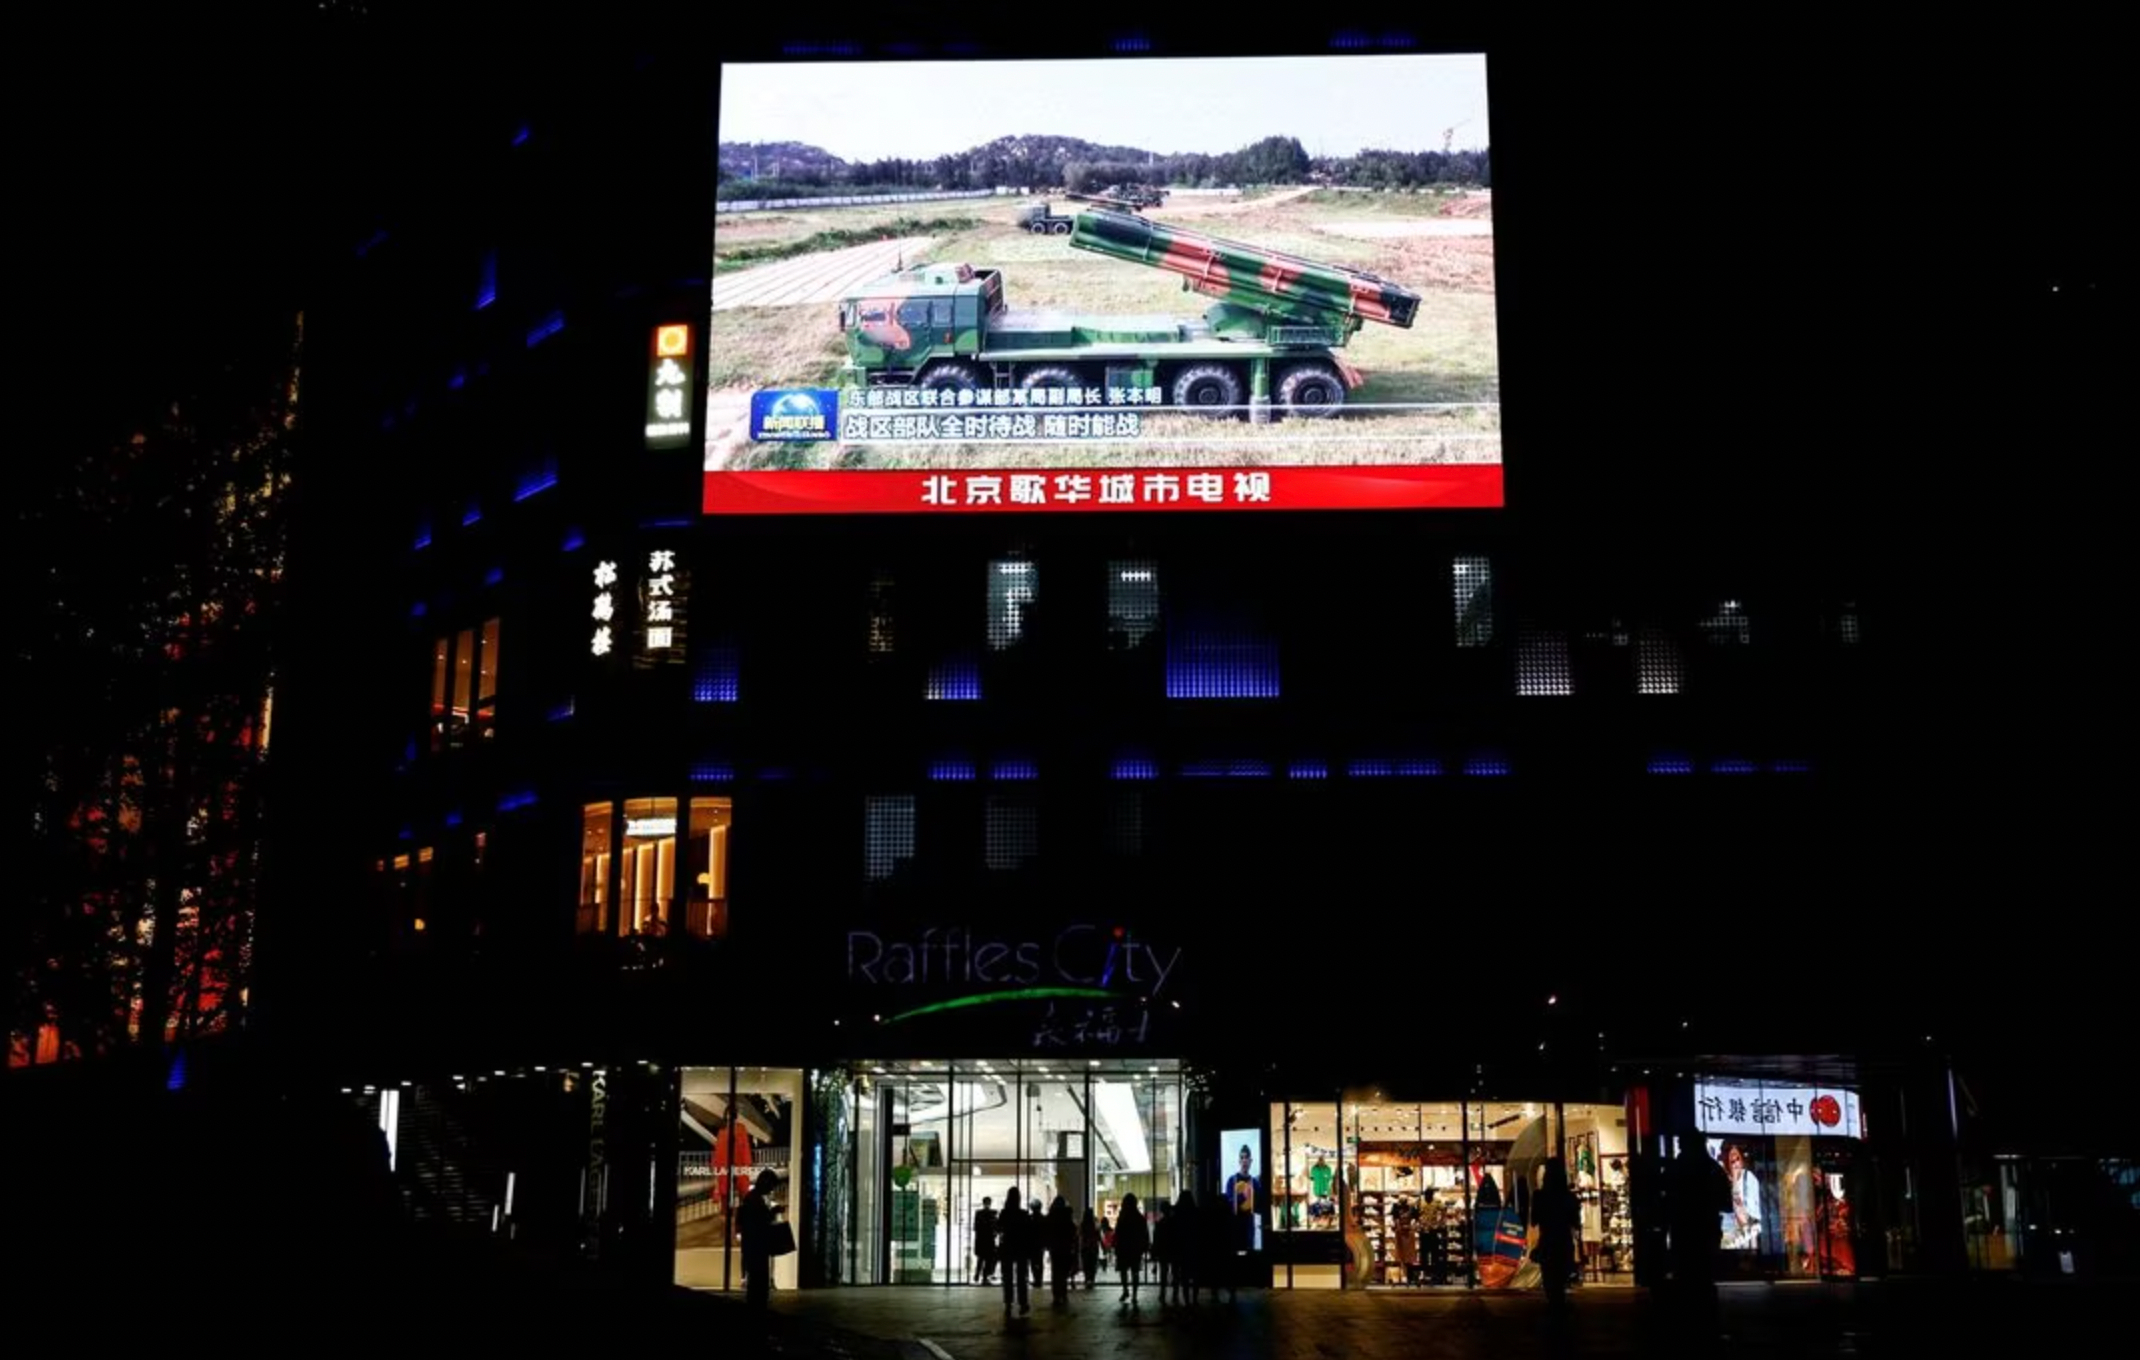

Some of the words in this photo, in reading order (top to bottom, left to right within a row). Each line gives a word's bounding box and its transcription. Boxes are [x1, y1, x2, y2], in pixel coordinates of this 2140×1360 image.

[845, 414, 1036, 438] 战区部队全时待战
[1043, 413, 1139, 437] 随时能战
[921, 472, 1272, 504] 北京歌华城市电视
[847, 924, 1041, 984] Raffles
[1053, 923, 1183, 998] City
[591, 1069, 608, 1136] KARL
[683, 1166, 712, 1176] KARL
